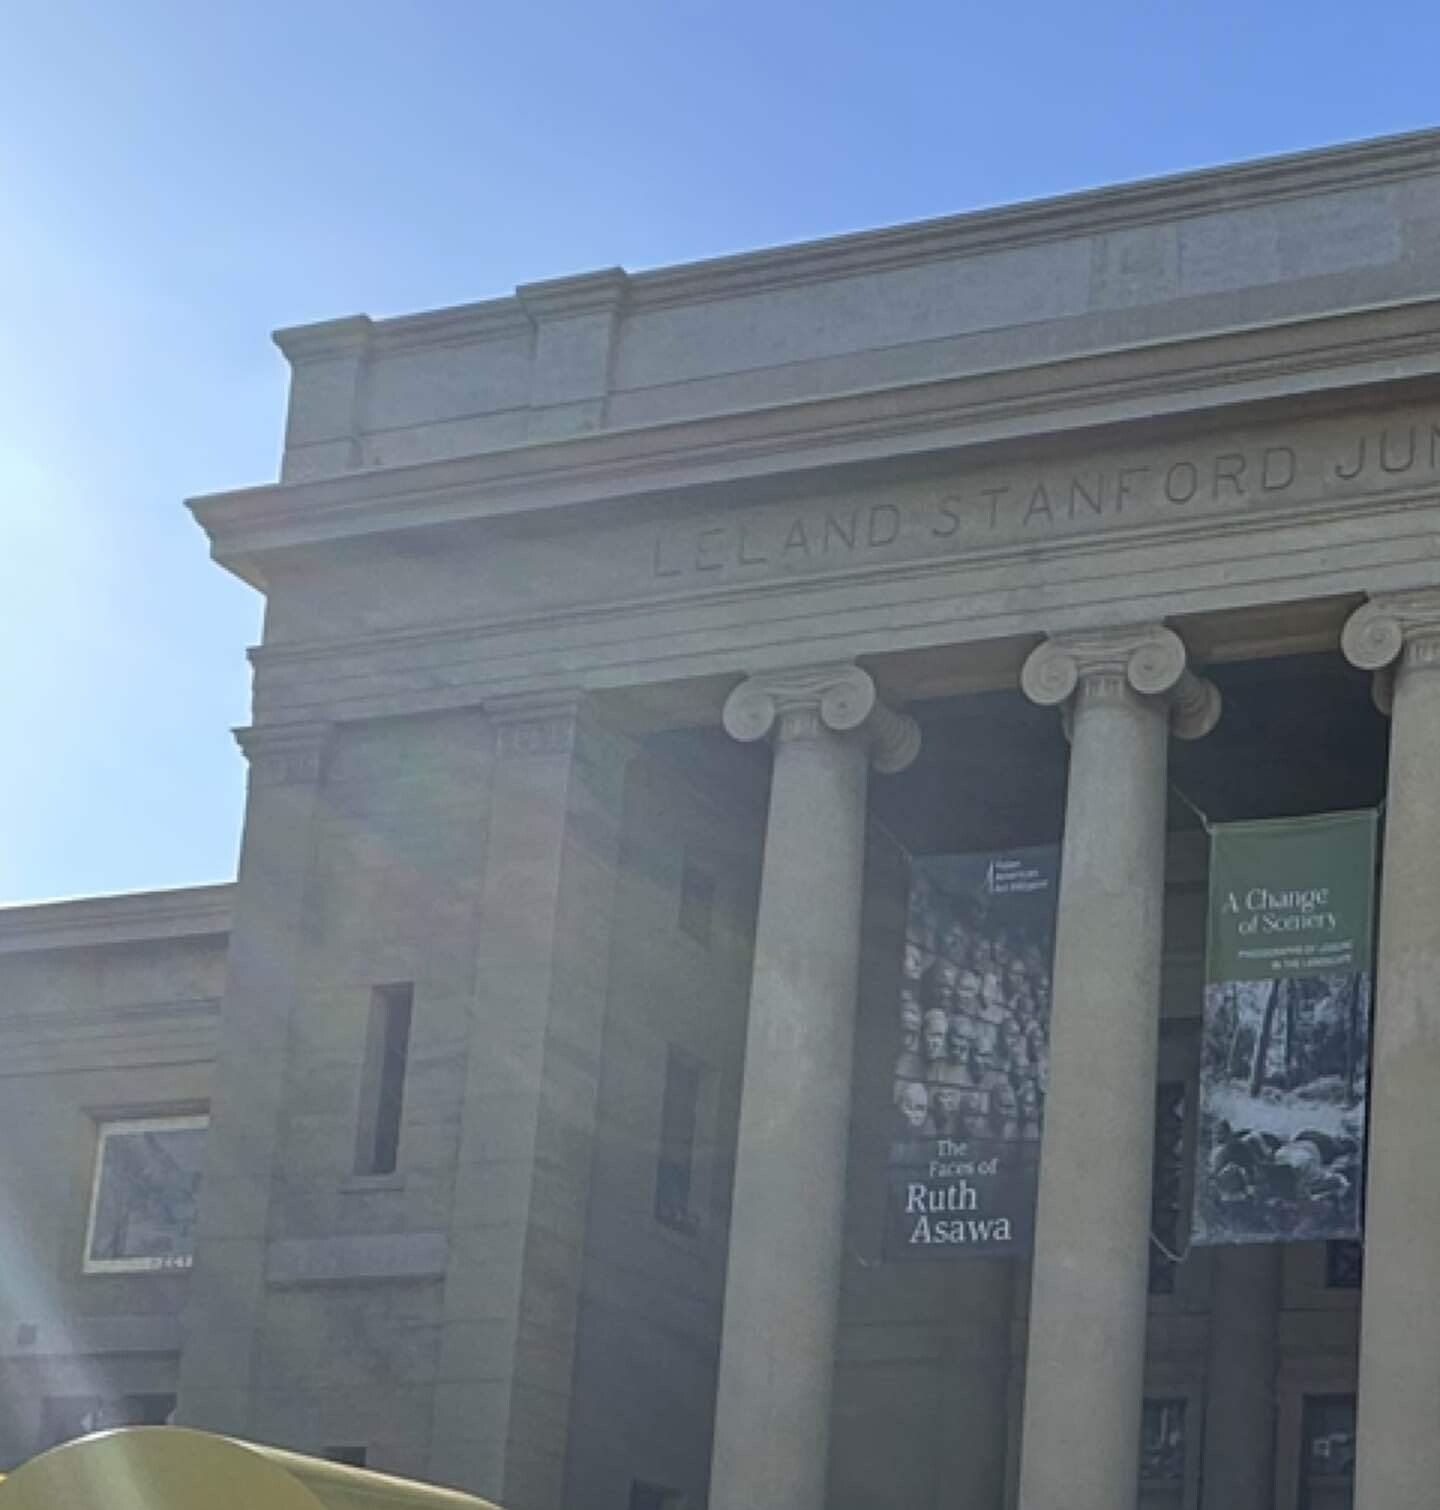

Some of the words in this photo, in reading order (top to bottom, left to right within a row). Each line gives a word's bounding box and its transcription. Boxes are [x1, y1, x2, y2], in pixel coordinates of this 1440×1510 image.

[650, 503, 902, 579] LELAND
[930, 445, 1298, 539] STANFORD
[1220, 892, 1240, 913] A
[1247, 887, 1329, 913] Change
[1237, 914, 1258, 935] of
[936, 1138, 968, 1156] The
[929, 1160, 975, 1177] Faces
[977, 1158, 999, 1175] of
[905, 1179, 977, 1213] Ruth
[909, 1215, 1012, 1243] Asawa
